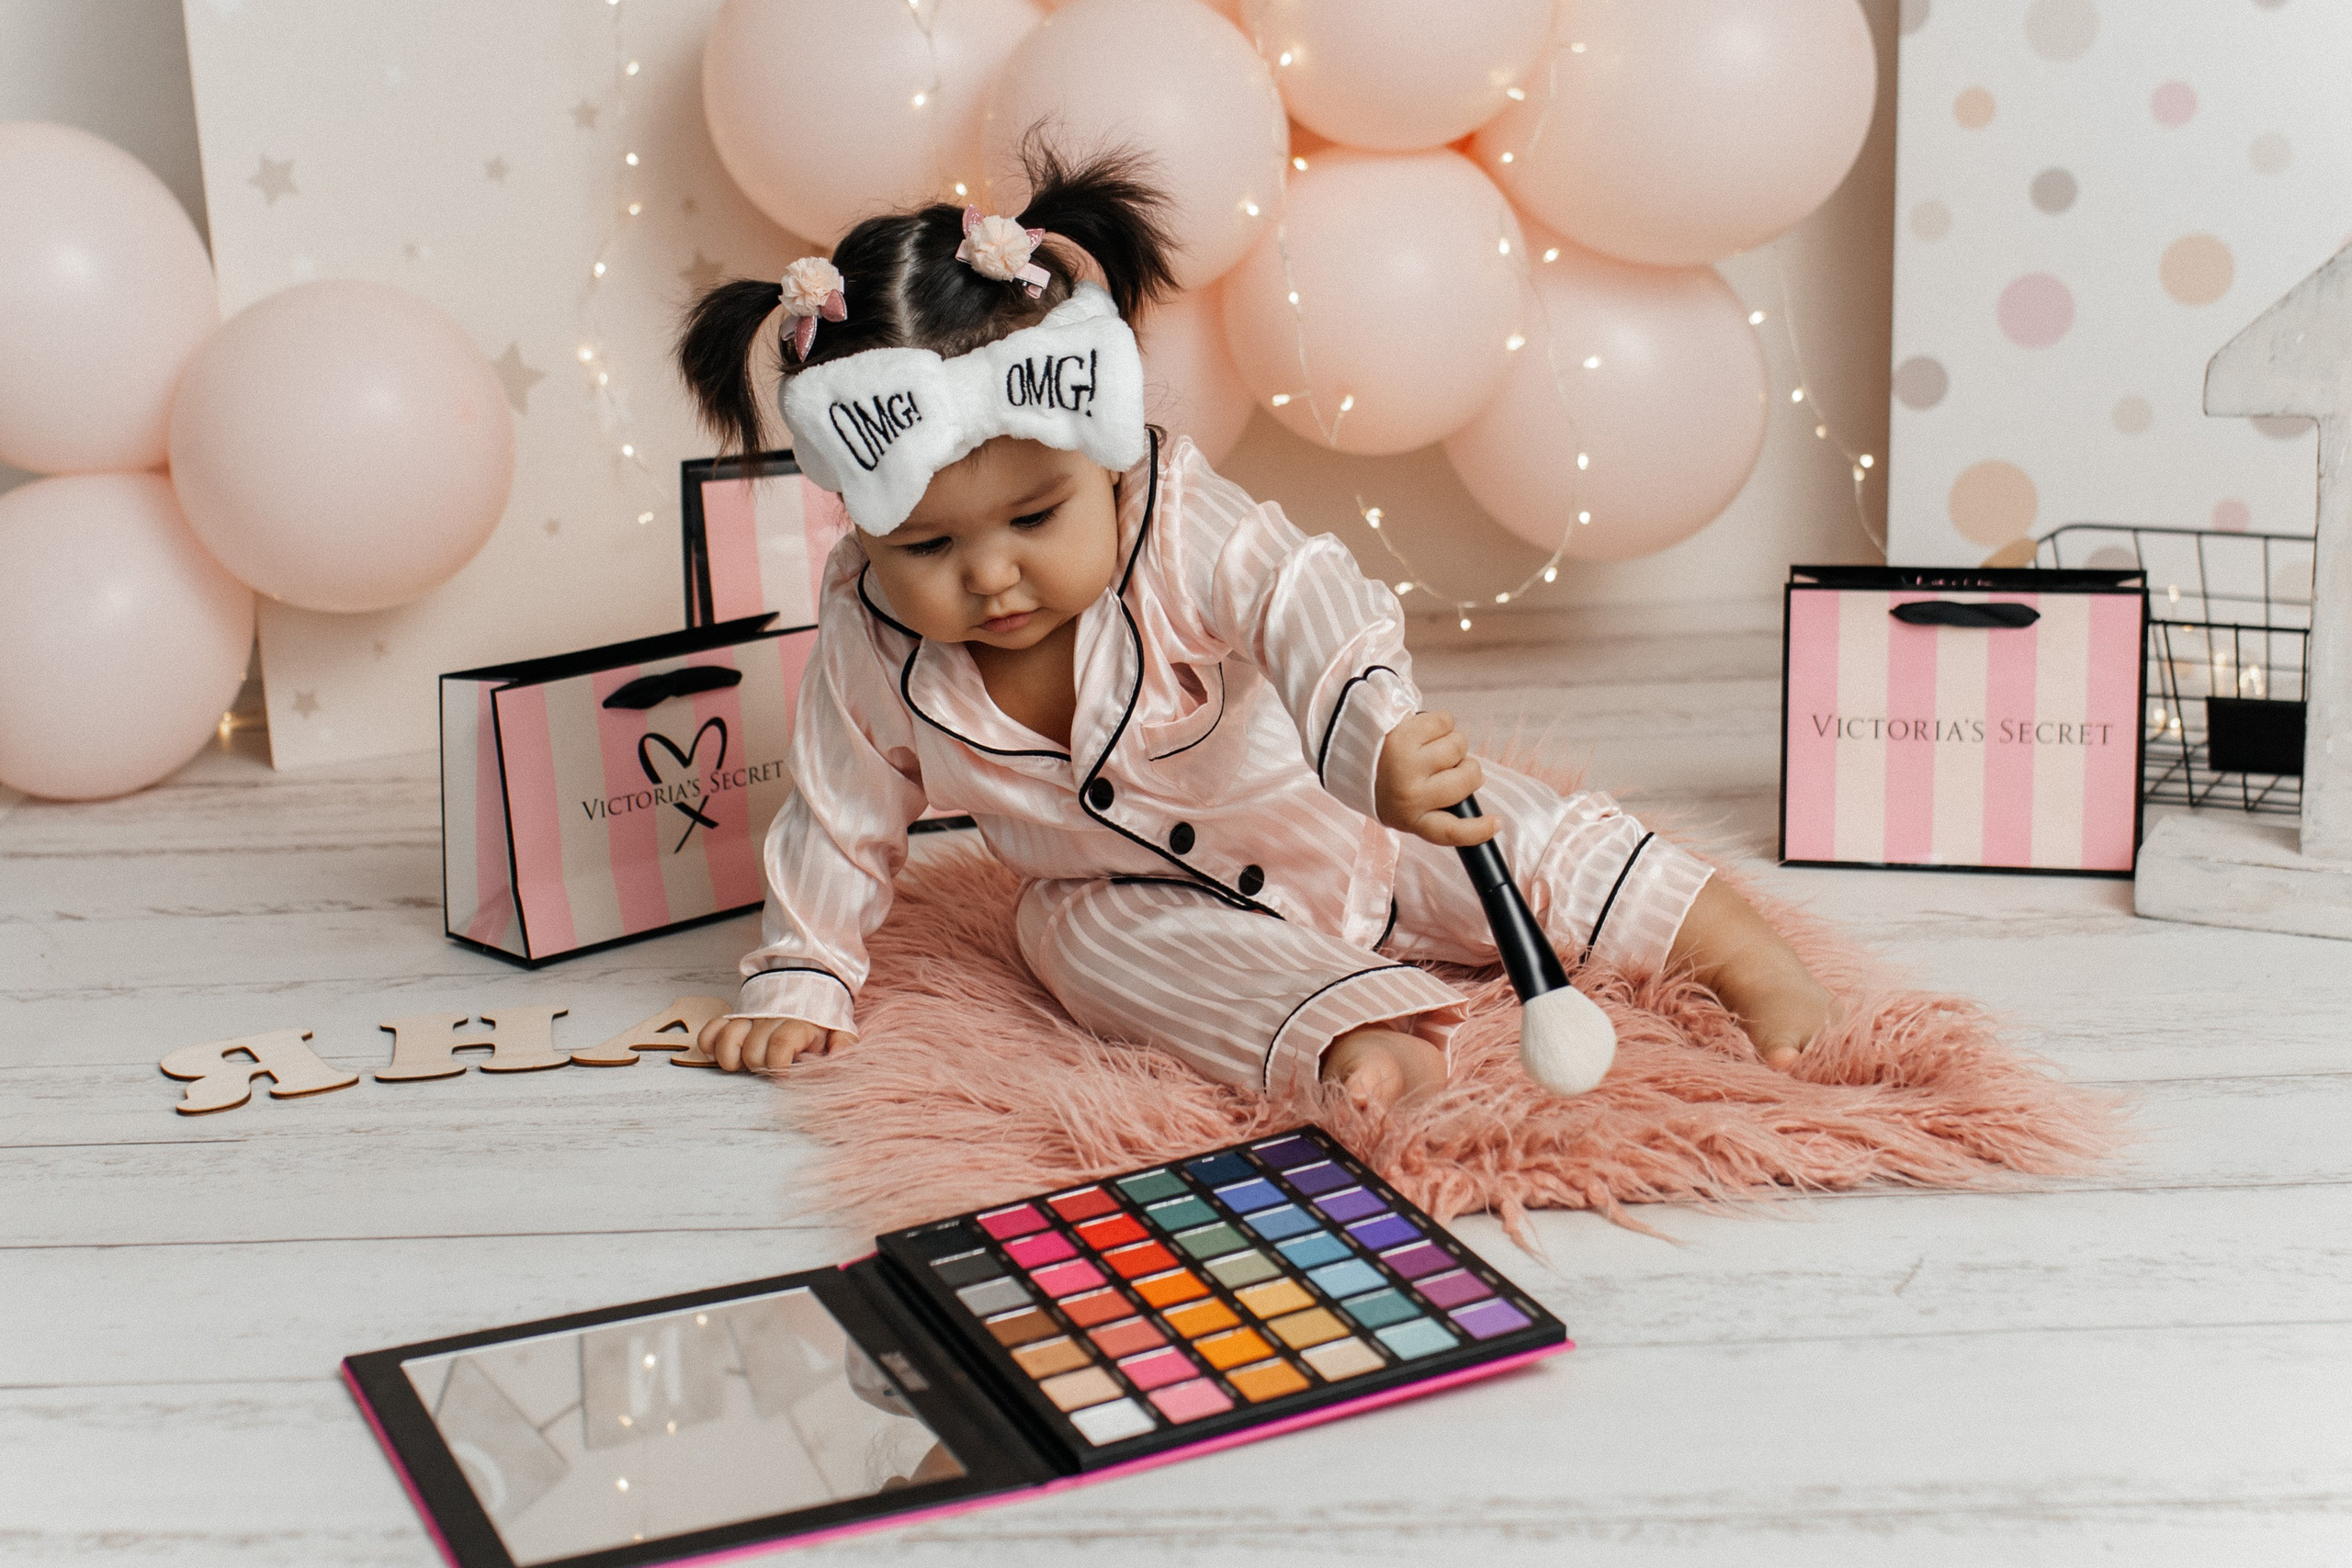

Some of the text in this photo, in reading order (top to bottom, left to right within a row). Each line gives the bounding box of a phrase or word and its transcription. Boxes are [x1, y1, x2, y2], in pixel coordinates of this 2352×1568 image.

[1006, 348, 1097, 417] OMG!
[829, 389, 922, 471] OMG!
[1813, 714, 2114, 746] VICTORIA'S SECRET
[582, 760, 785, 820] VICTORIA'S SECRET
